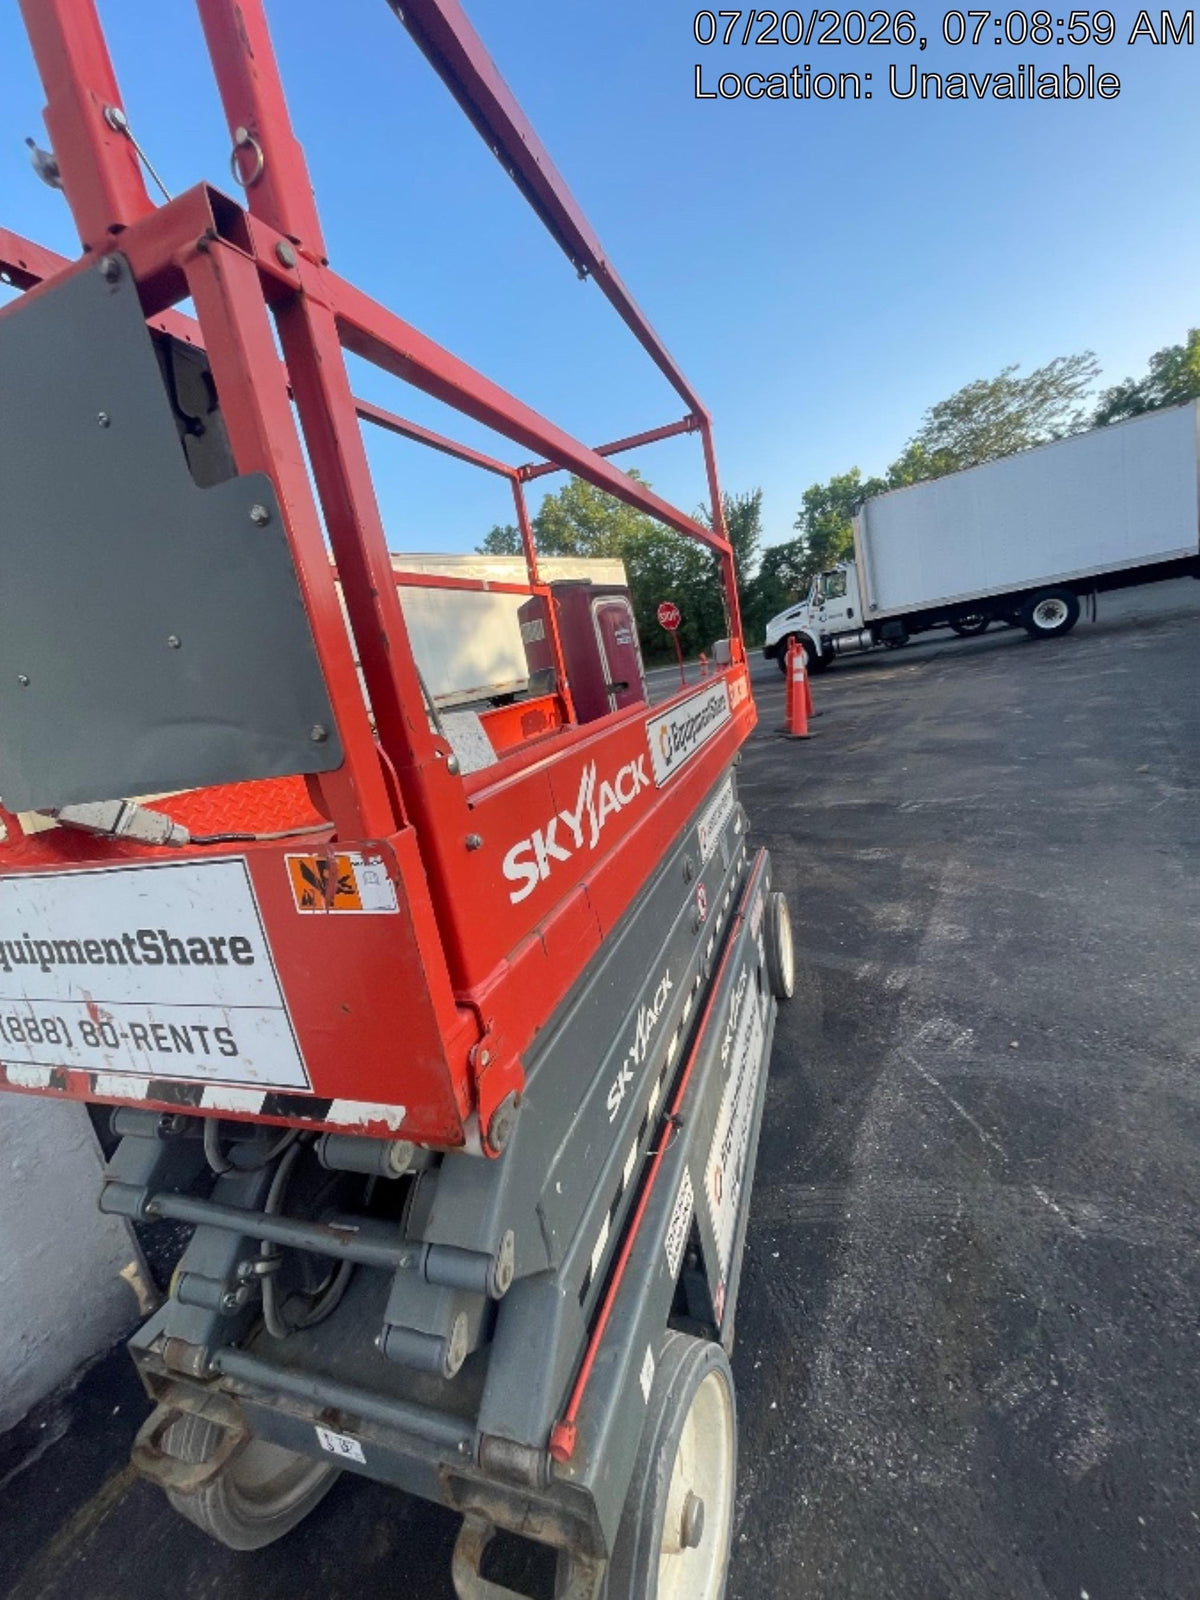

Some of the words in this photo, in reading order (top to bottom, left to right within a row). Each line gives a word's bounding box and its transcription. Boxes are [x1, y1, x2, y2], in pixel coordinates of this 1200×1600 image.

[502, 758, 652, 905] SKYJACK
[0, 929, 255, 973] quipmentShare
[0, 1014, 73, 1048] (888)
[78, 1020, 239, 1056] 80-RENTS
[607, 968, 674, 1124] SKYJACK
